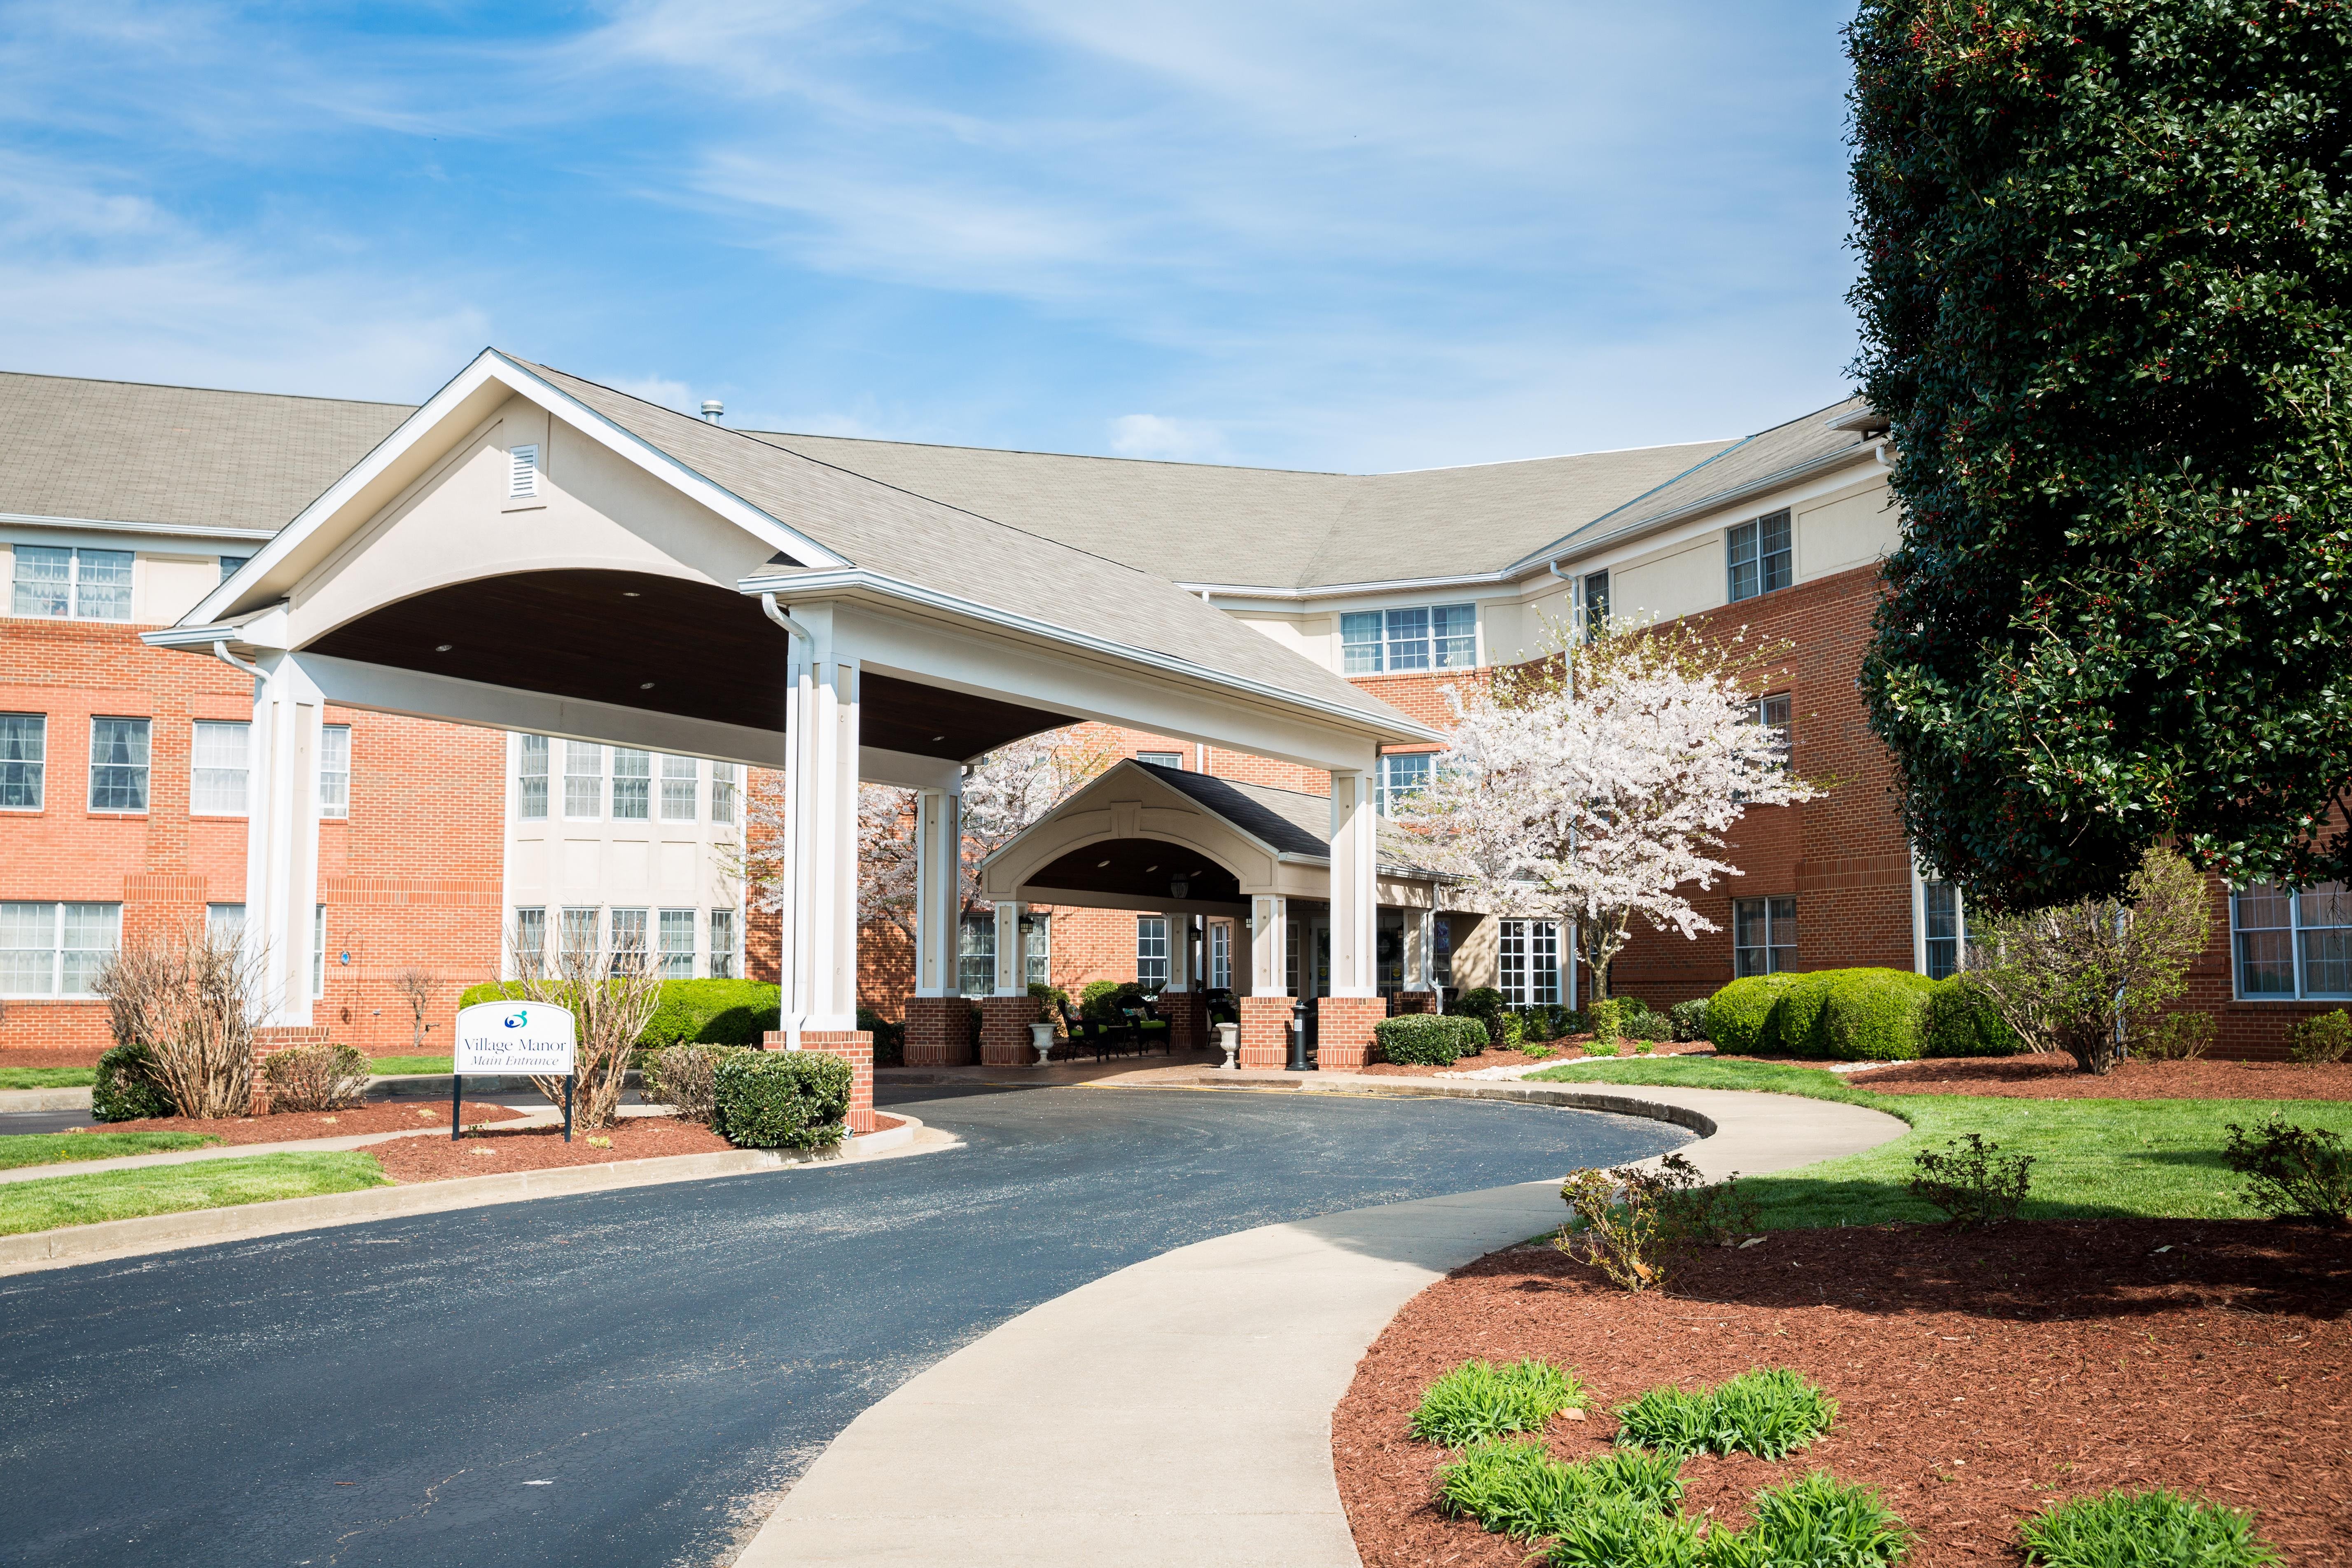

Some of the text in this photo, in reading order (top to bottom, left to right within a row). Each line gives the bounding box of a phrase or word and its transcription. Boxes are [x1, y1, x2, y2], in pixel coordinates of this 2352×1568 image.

[464, 1038, 567, 1054] Village Manor
[470, 1056, 559, 1066] Main Entrance
